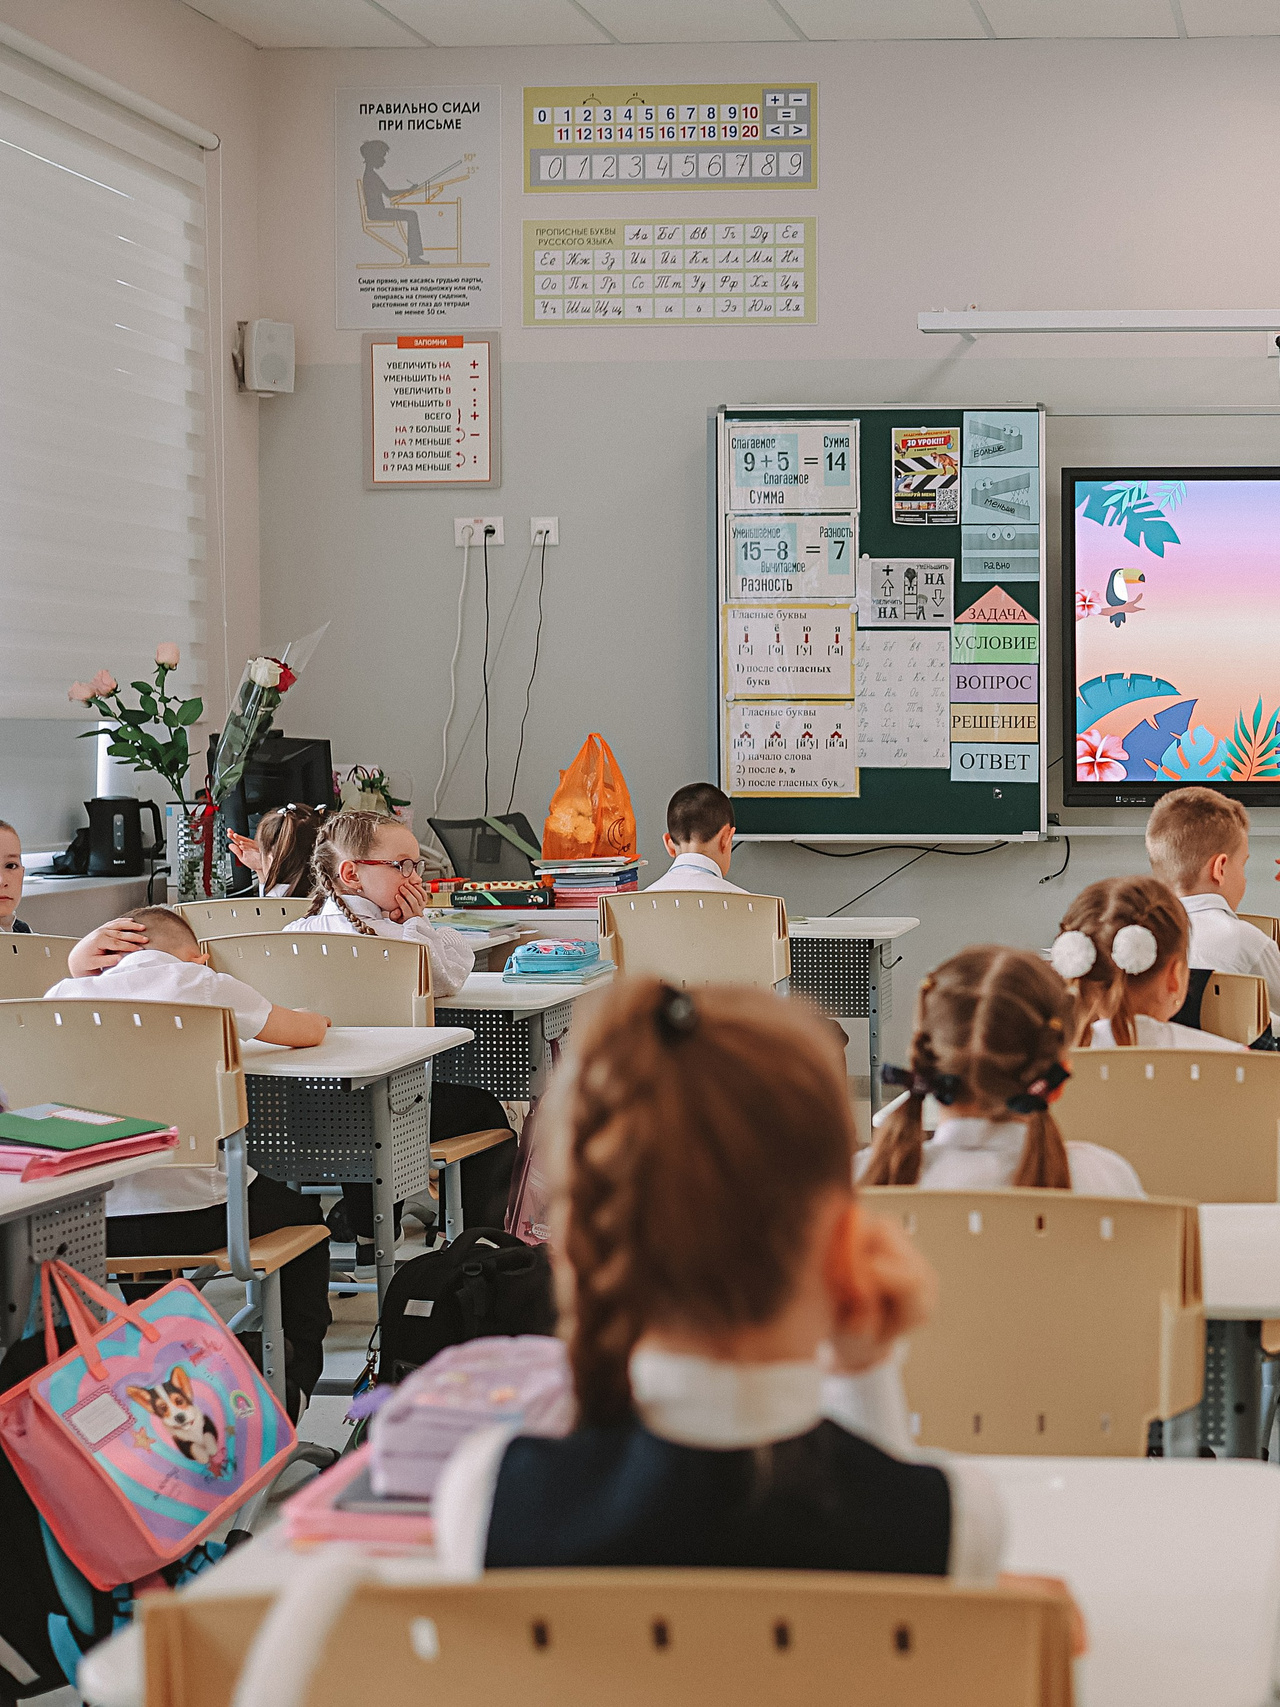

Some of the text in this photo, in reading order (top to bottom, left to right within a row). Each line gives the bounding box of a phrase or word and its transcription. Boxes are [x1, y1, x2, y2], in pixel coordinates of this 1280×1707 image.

[360, 102, 480, 114] ПРАВИЛЬНО СИДИ
[538, 107, 758, 121] 0 1 2 3 4 5 6 7 8 9 10
[379, 119, 461, 130] ПРИ ПИСЬМЕ
[558, 126, 758, 140] 11 12 13 14 15 16 17 18 19 20
[536, 228, 588, 236] ПРОПИСНЫЕ
[539, 238, 584, 246] РУССКОГО
[732, 436, 849, 449] Слагаемое Сумма
[744, 452, 846, 471] 9 5 14
[764, 473, 808, 484] Слагаемое
[750, 490, 784, 505] Сумма
[732, 527, 853, 538] Уменьшаемое Разность
[833, 541, 845, 559] 7
[761, 562, 805, 573] Вычитаемое
[742, 578, 792, 592] Разность
[925, 573, 945, 585] НА
[732, 610, 807, 621] Гласные буквы
[878, 607, 898, 618] НА
[968, 608, 1027, 621] ЗАДАЧА
[954, 636, 1037, 650] УСЛОВИЕ
[777, 665, 831, 673] согласных
[747, 677, 770, 686] букв
[956, 675, 1032, 689] ВОПРОС
[742, 707, 816, 718] Гласные буквы
[952, 716, 1036, 729] РЕШЕНИЕ
[960, 755, 1030, 770] ОТВЕТ
[736, 765, 745, 774] 2)
[736, 778, 745, 787] 3)
[822, 778, 839, 788] бук
